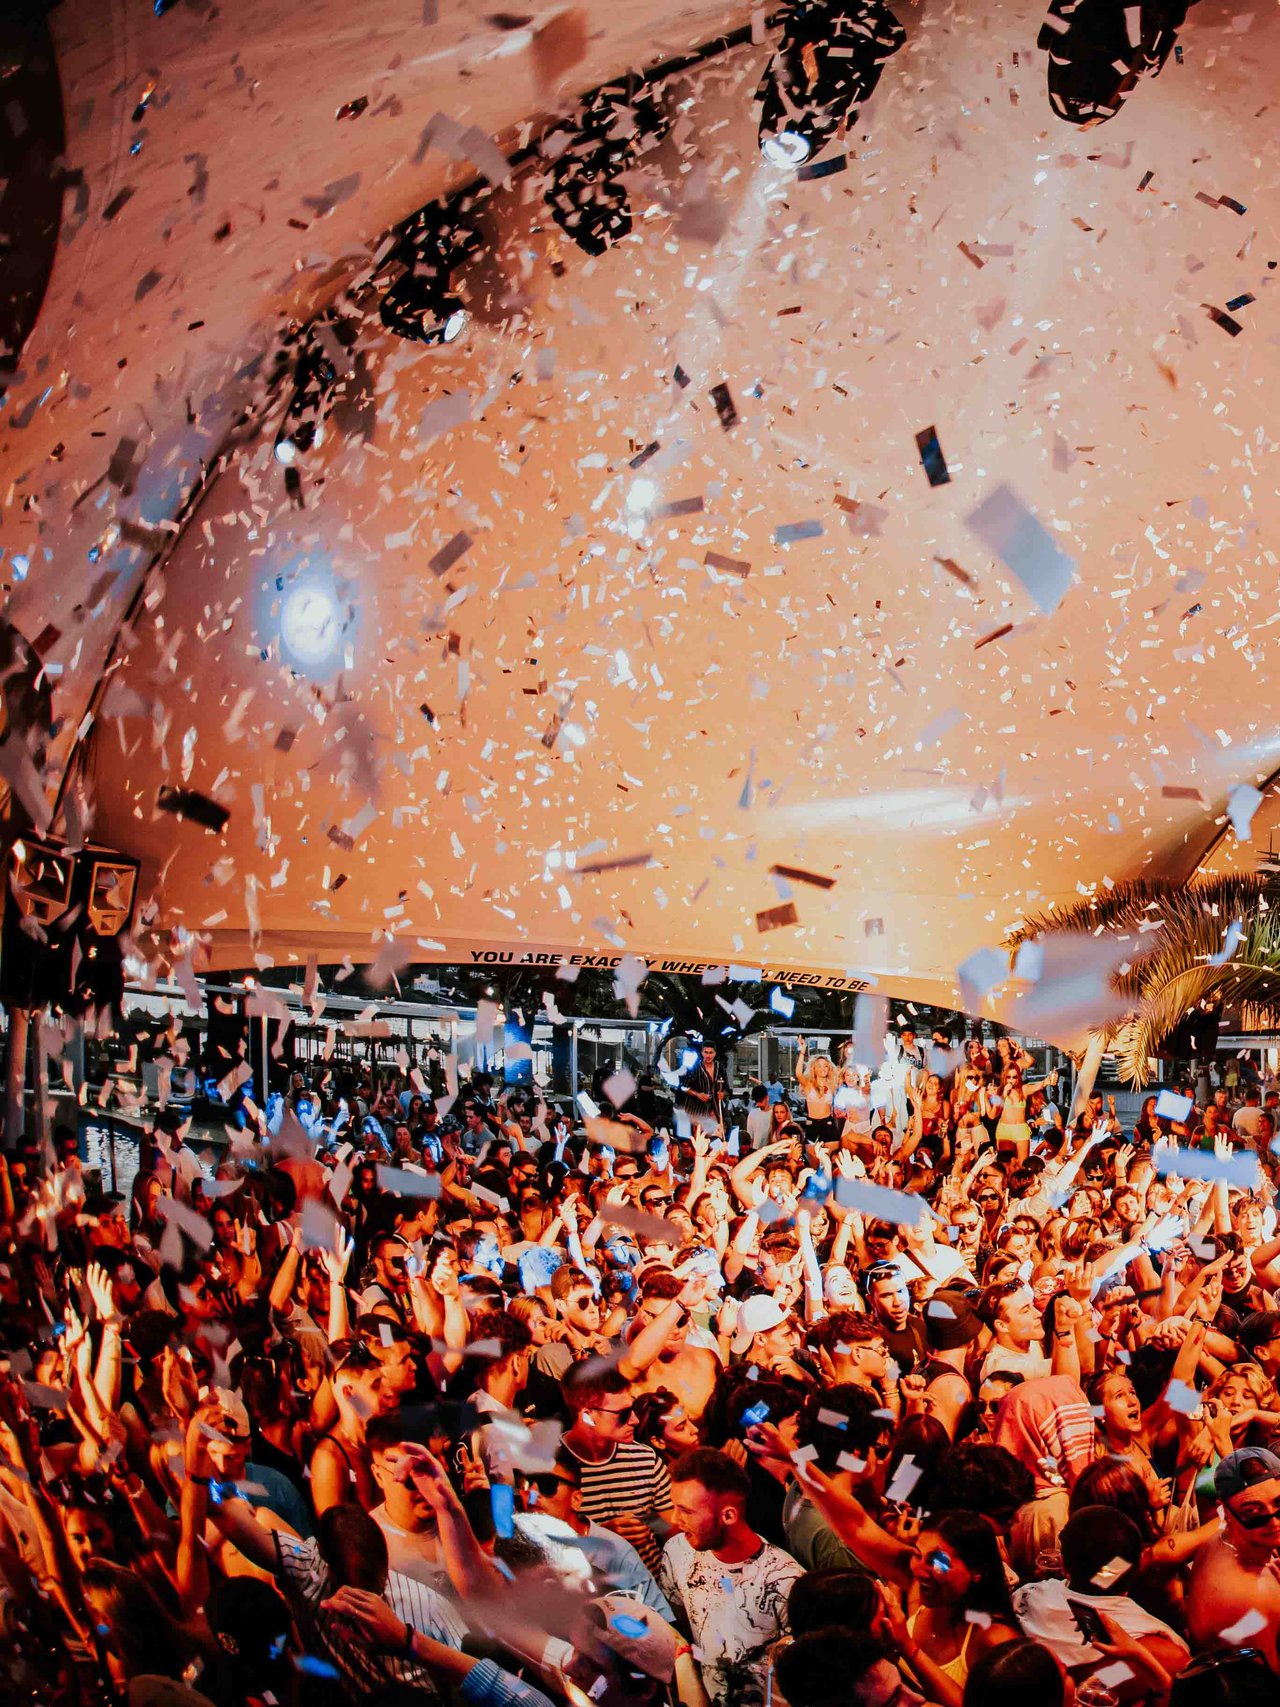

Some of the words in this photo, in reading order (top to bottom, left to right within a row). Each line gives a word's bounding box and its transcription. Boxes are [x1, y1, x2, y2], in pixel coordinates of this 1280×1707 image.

[471, 951, 514, 963] YOU
[520, 953, 563, 964] ARE
[569, 955, 656, 968] EXACY
[774, 971, 821, 985] NEED
[823, 977, 846, 988] TO
[848, 979, 870, 991] BE
